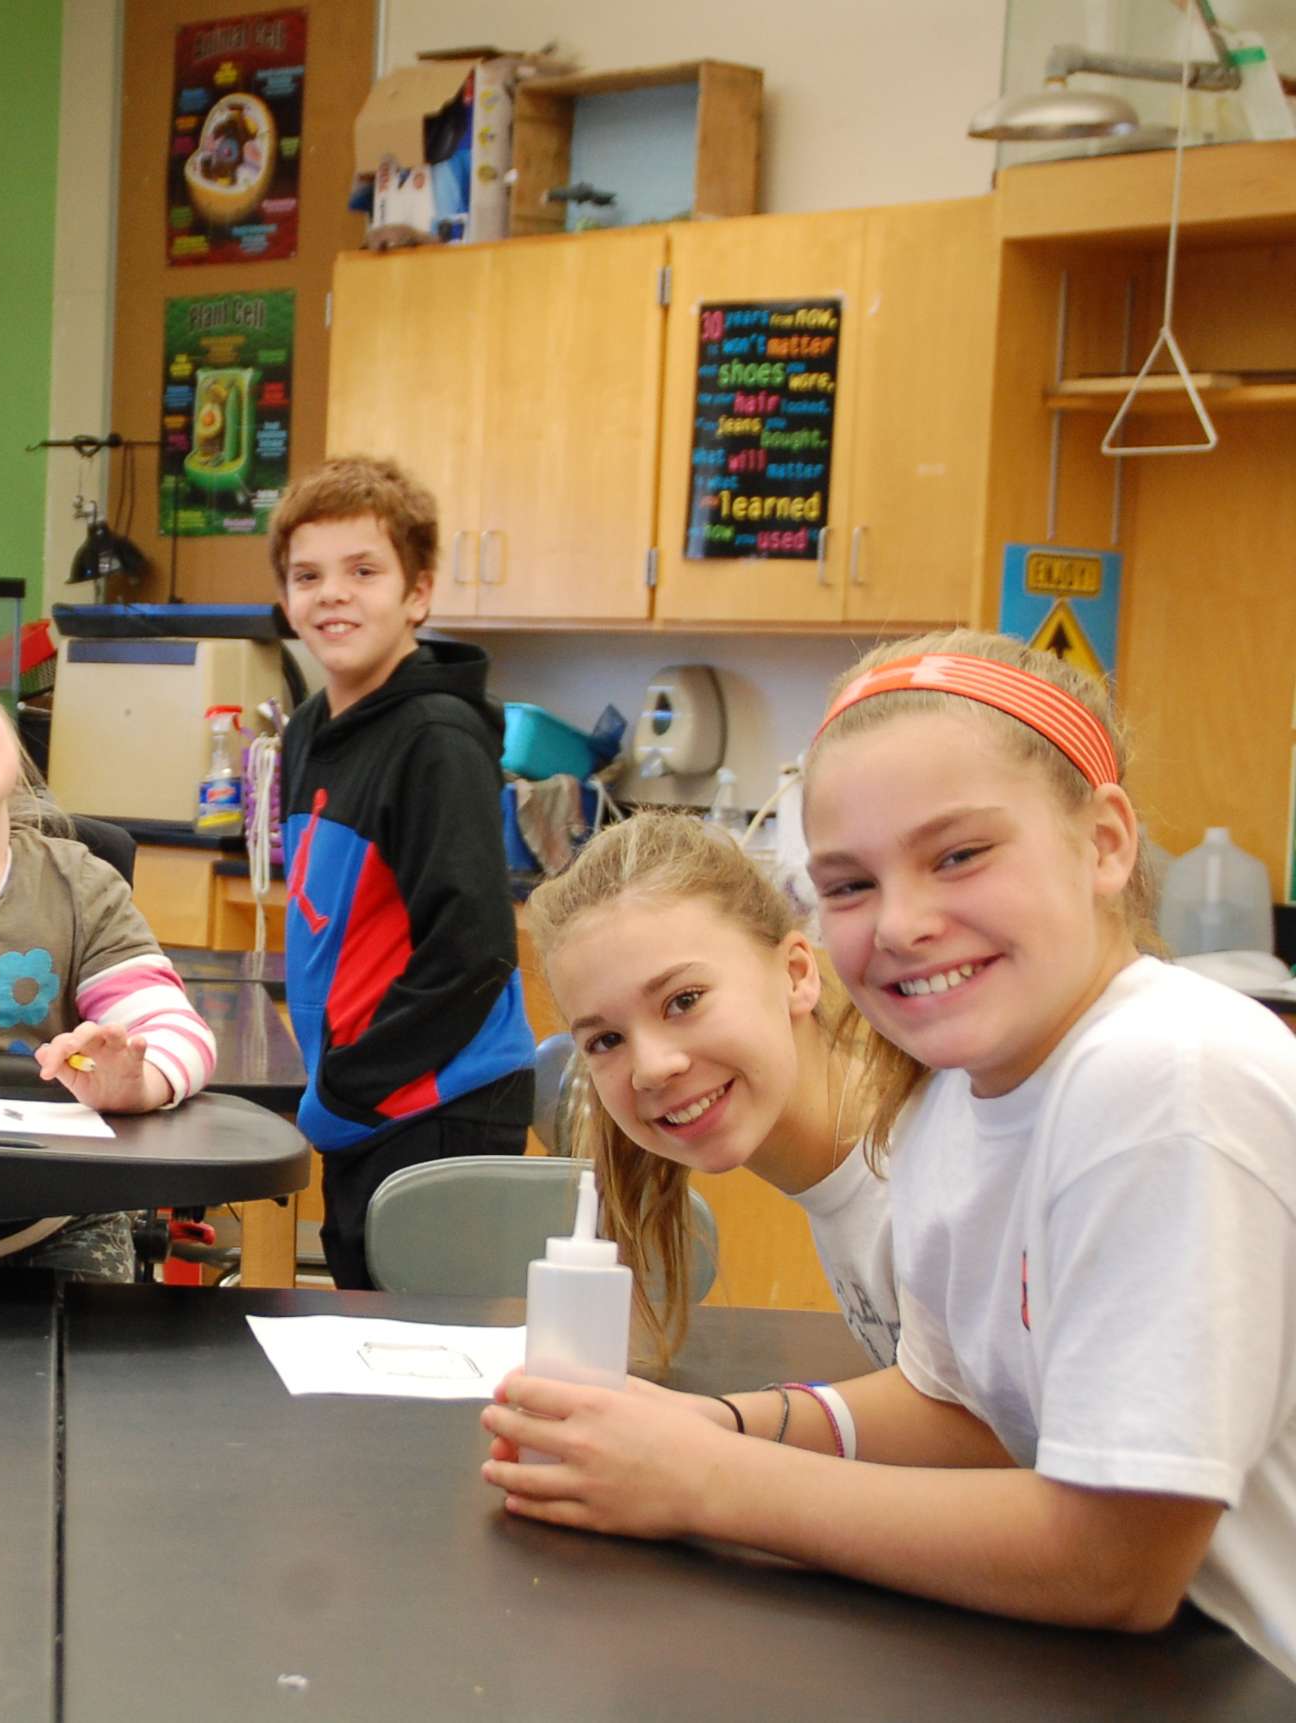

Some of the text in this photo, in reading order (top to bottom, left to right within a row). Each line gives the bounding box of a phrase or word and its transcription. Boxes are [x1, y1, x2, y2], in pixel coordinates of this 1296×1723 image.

[190, 296, 266, 330] Plant Cell
[702, 310, 724, 341] 30
[725, 309, 769, 329] years
[721, 333, 767, 356] won't
[767, 334, 836, 358] matter
[718, 358, 785, 388] shoes
[733, 389, 780, 415] hair
[715, 414, 761, 439] jeans
[727, 447, 768, 474] will
[767, 461, 824, 480] matter
[720, 490, 822, 522] learned
[757, 526, 808, 552] used
